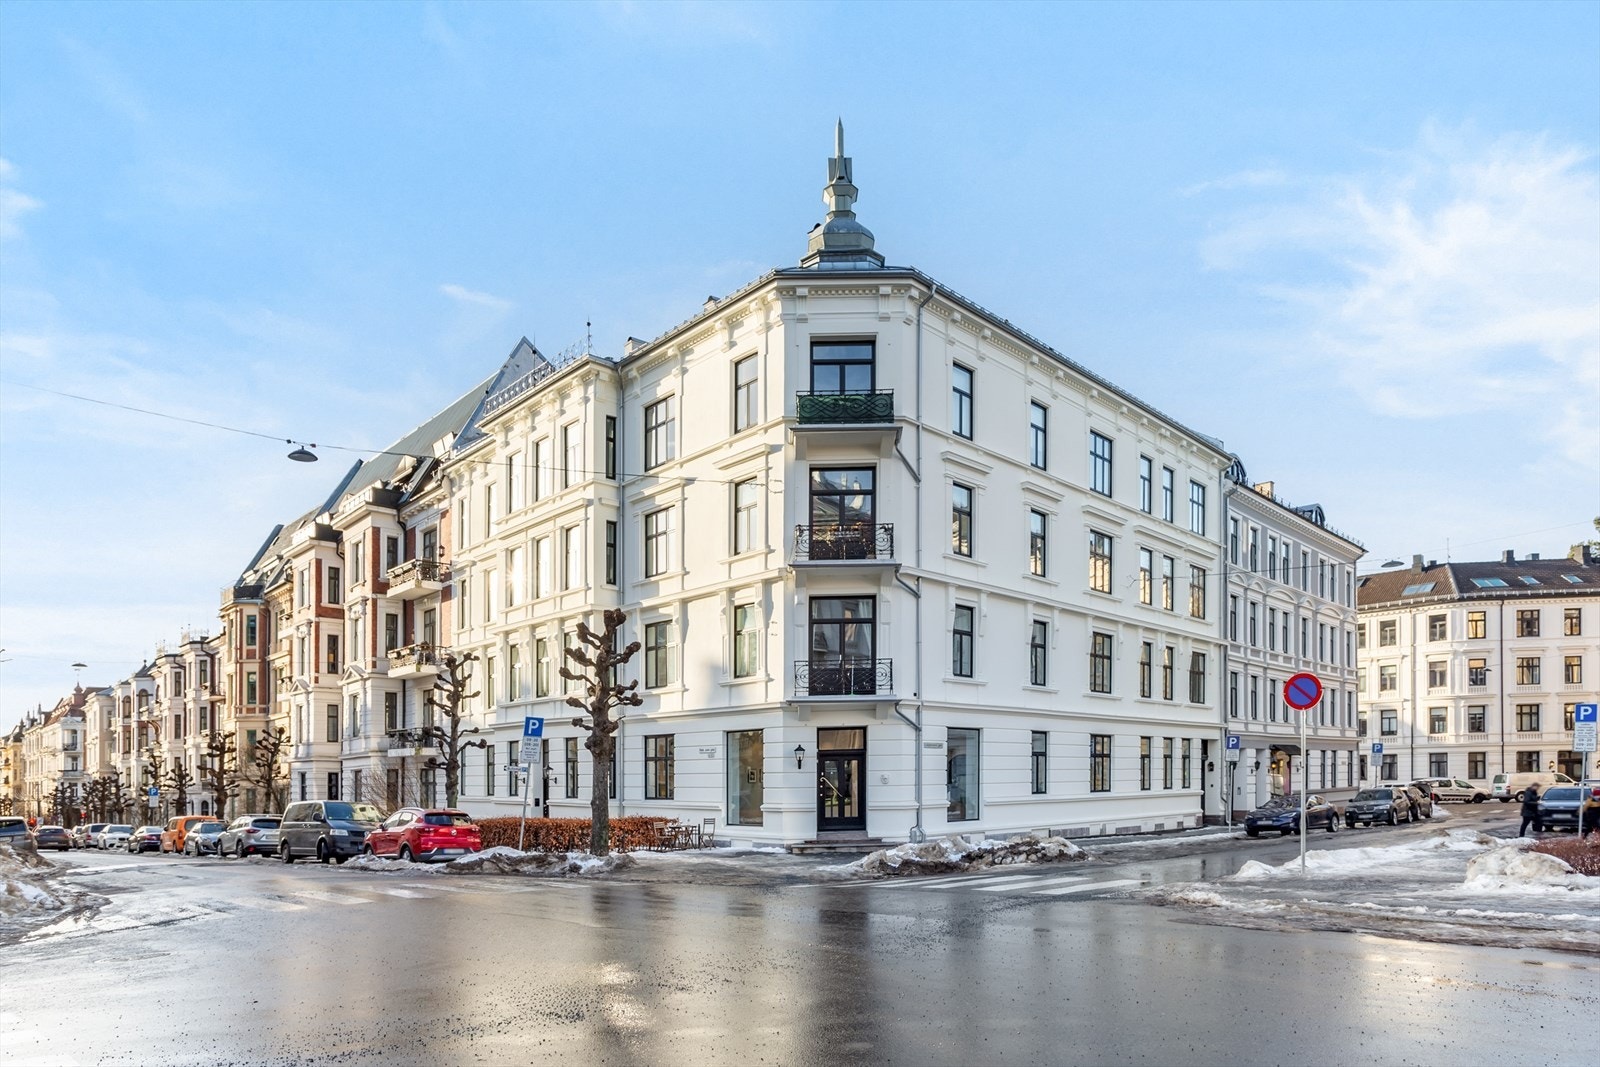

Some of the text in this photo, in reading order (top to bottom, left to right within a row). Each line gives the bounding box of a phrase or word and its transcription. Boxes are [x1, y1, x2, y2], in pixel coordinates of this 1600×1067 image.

[1580, 706, 1592, 720] P
[528, 719, 539, 735] P
[1229, 737, 1237, 748] P
[1374, 744, 1381, 752] P
